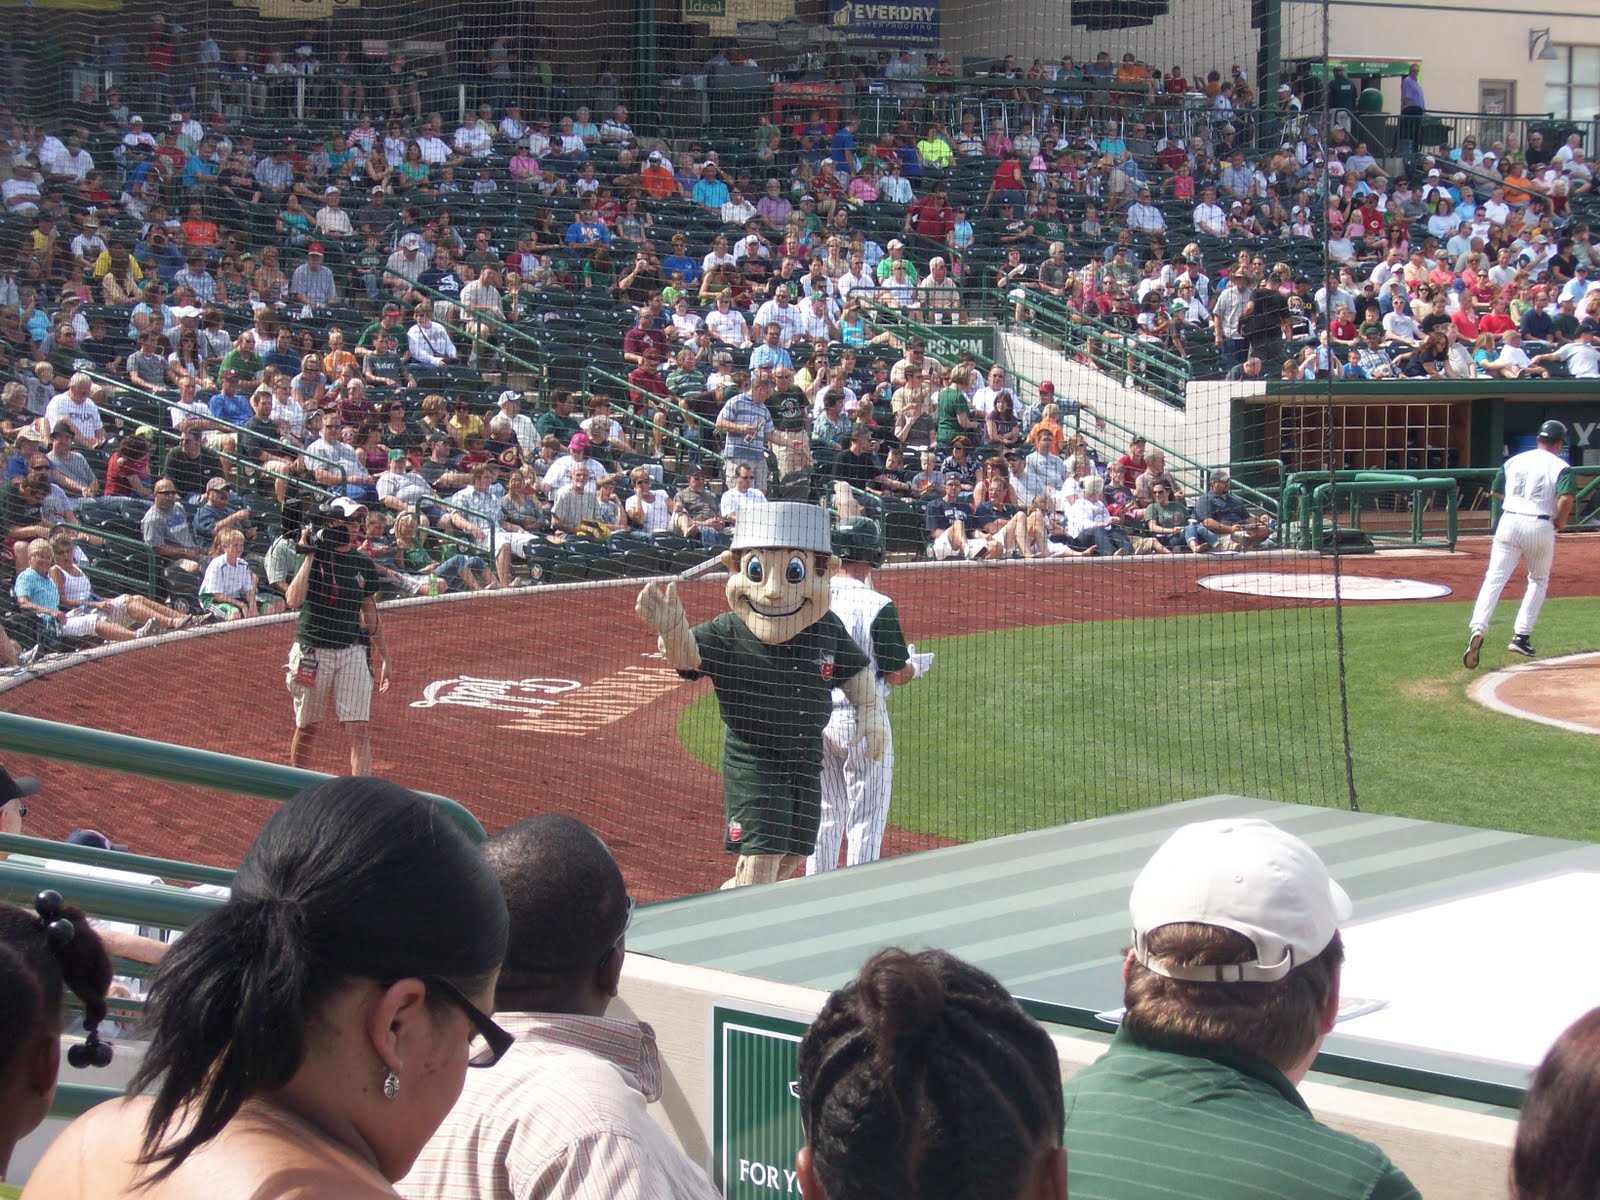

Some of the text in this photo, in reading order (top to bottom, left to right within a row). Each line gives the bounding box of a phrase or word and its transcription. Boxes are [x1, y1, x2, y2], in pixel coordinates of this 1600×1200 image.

[689, 0, 721, 12] Ideal
[855, 4, 935, 21] EVERDRY
[925, 339, 983, 355] PS.COM
[1572, 422, 1600, 447] Y
[739, 1158, 780, 1190] FOR
